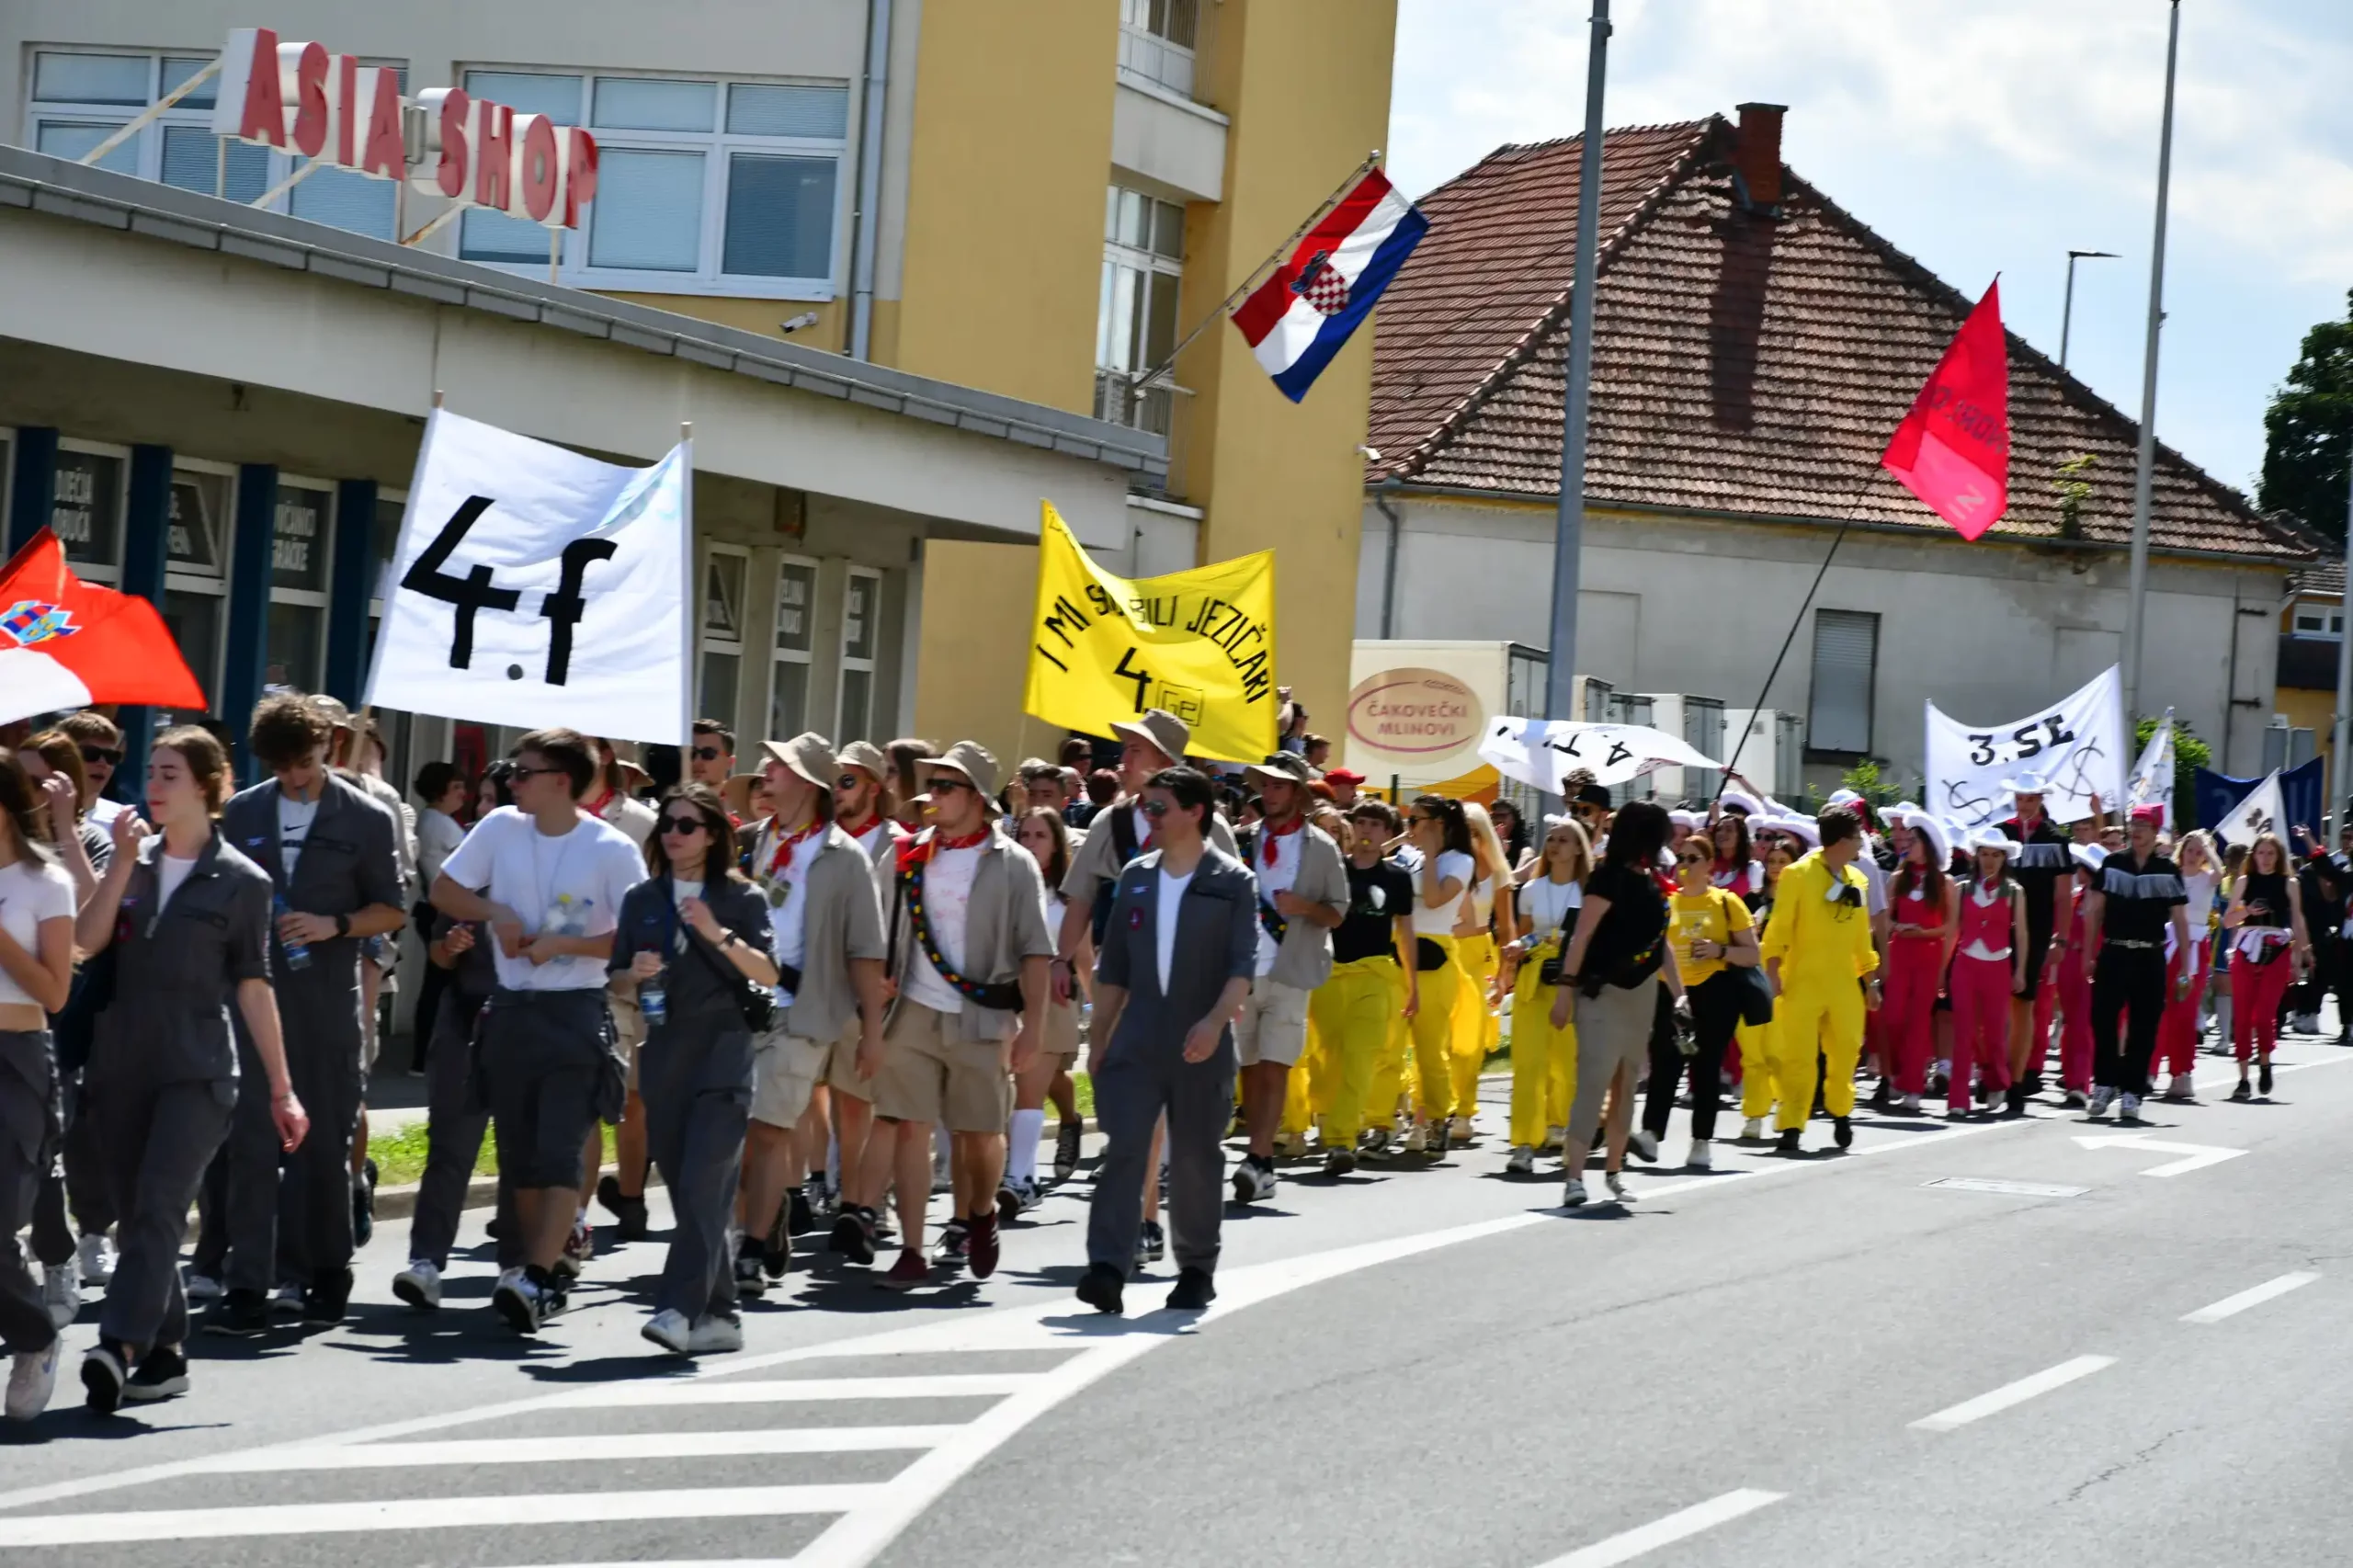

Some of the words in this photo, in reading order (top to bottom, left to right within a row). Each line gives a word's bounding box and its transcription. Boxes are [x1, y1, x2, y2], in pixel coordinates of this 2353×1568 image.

[238, 28, 404, 181] ASIA
[437, 88, 598, 229] SHOP
[400, 494, 618, 687] 4.f
[1044, 595, 1092, 649] MI
[1036, 643, 1068, 673] I
[1185, 597, 1270, 704] JEZIČARI
[1367, 700, 1468, 718] ČAKOVEČKI
[1379, 722, 1456, 735] MLINOVI
